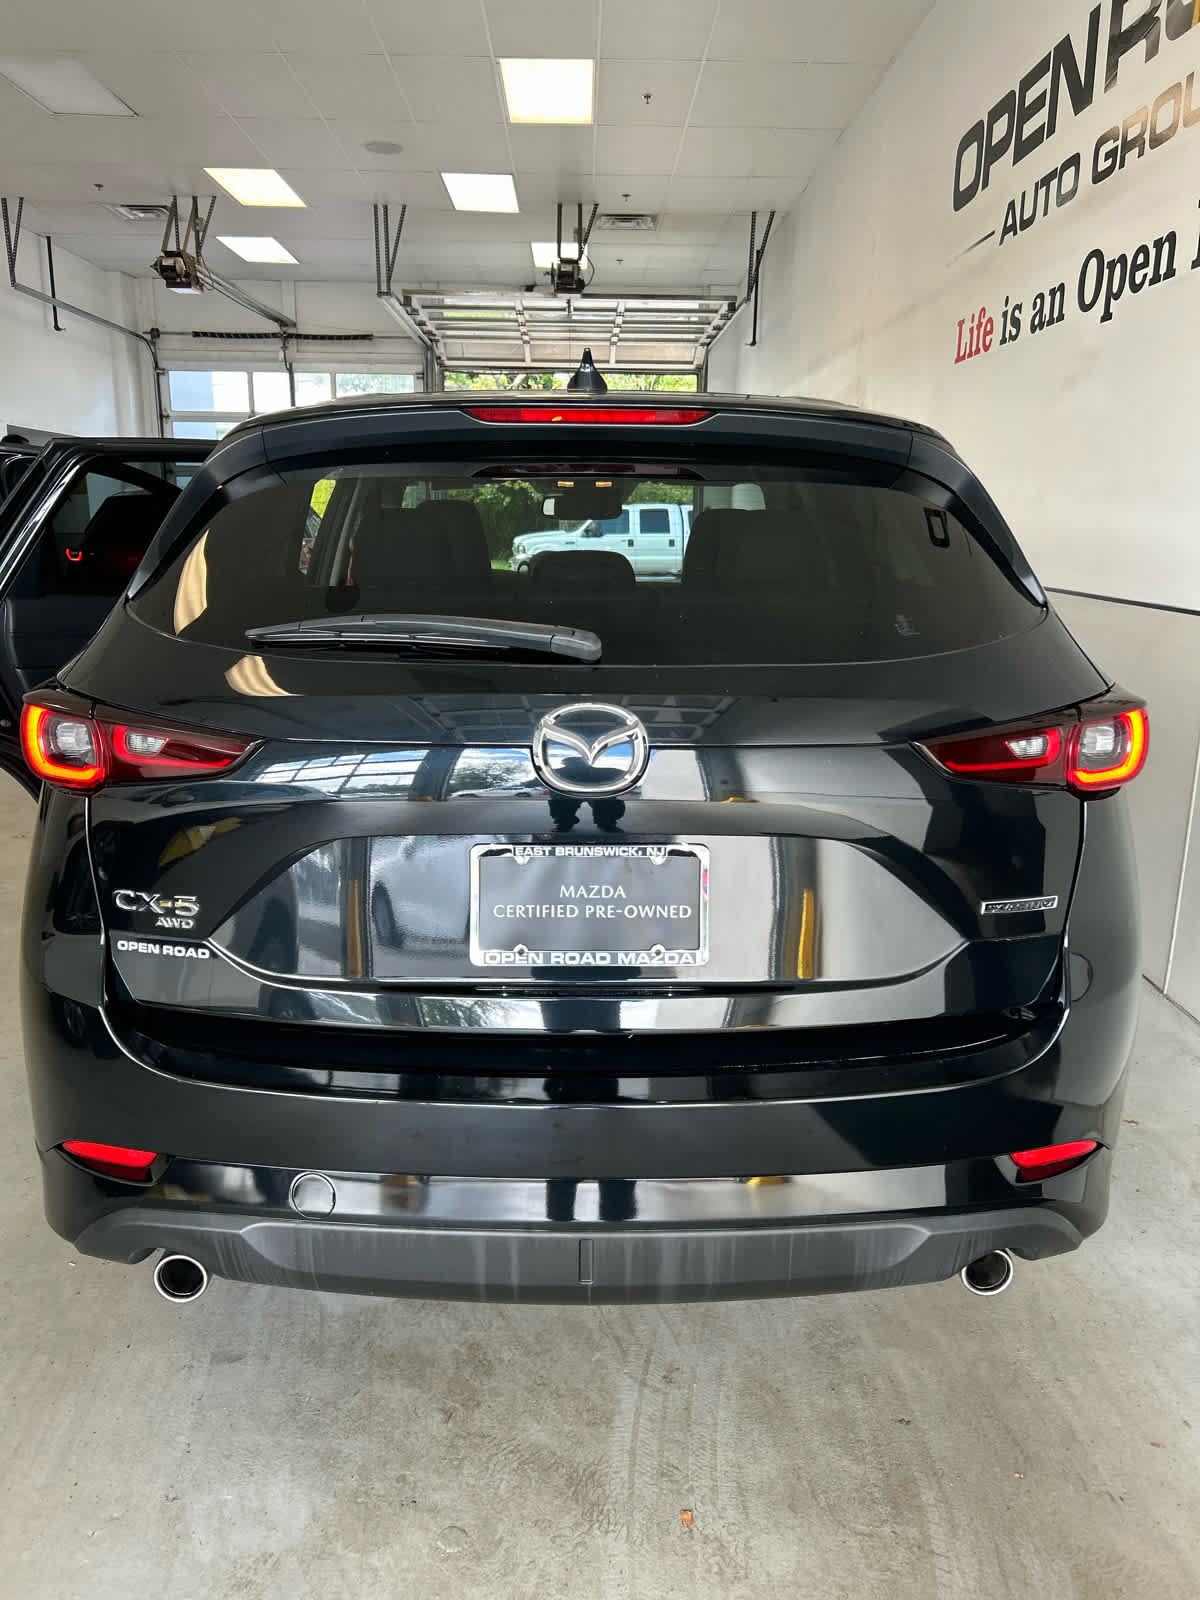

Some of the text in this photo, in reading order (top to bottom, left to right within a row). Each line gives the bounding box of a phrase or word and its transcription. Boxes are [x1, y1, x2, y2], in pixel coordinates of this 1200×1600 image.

[998, 152, 1081, 246] AUTO
[954, 306, 994, 364] Life
[999, 296, 1022, 345] is
[1030, 282, 1065, 334] an
[1077, 230, 1177, 323] Open
[515, 846, 666, 857] EAST BRUNSWICK, NJ
[559, 885, 627, 899] MAZDA
[112, 889, 200, 917] CX-5
[493, 904, 692, 919] CERTIFIED PRE-OWNED
[155, 917, 194, 929] AWD
[117, 940, 210, 959] OPEN ROAD
[485, 952, 697, 965] OPEN ROAD MAZDA
